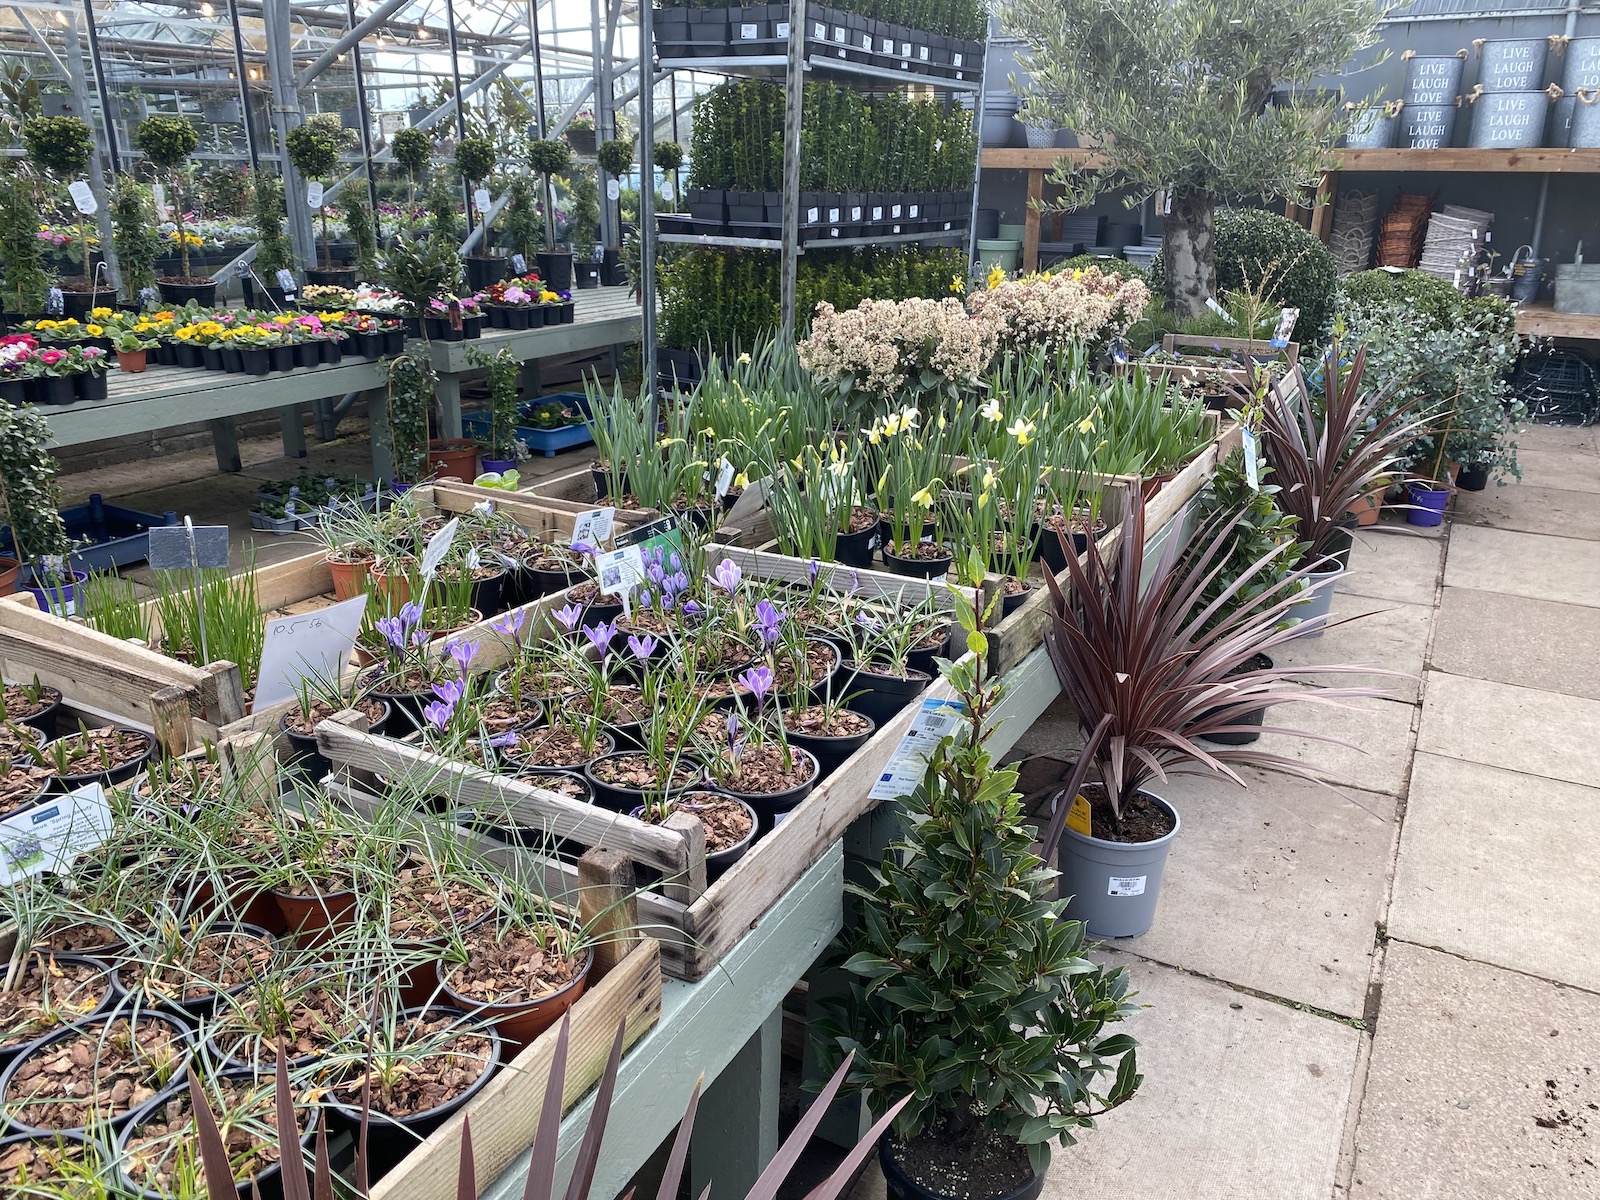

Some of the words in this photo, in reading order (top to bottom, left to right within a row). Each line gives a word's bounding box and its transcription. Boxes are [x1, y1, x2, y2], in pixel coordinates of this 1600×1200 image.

[1502, 47, 1530, 59] LIVE
[1419, 63, 1446, 75] LIVE
[1494, 61, 1533, 74] LAUGH
[1412, 78, 1449, 90] LAUGH
[1496, 76, 1528, 88] LOVE
[1413, 92, 1443, 103] LOVE
[1498, 99, 1526, 111] LIVE
[1416, 111, 1443, 122] LIVE
[1489, 114, 1530, 126] LAUGH
[1408, 125, 1446, 136] LAUGH
[1491, 129, 1523, 141] LOVE
[1410, 139, 1440, 150] LOVE
